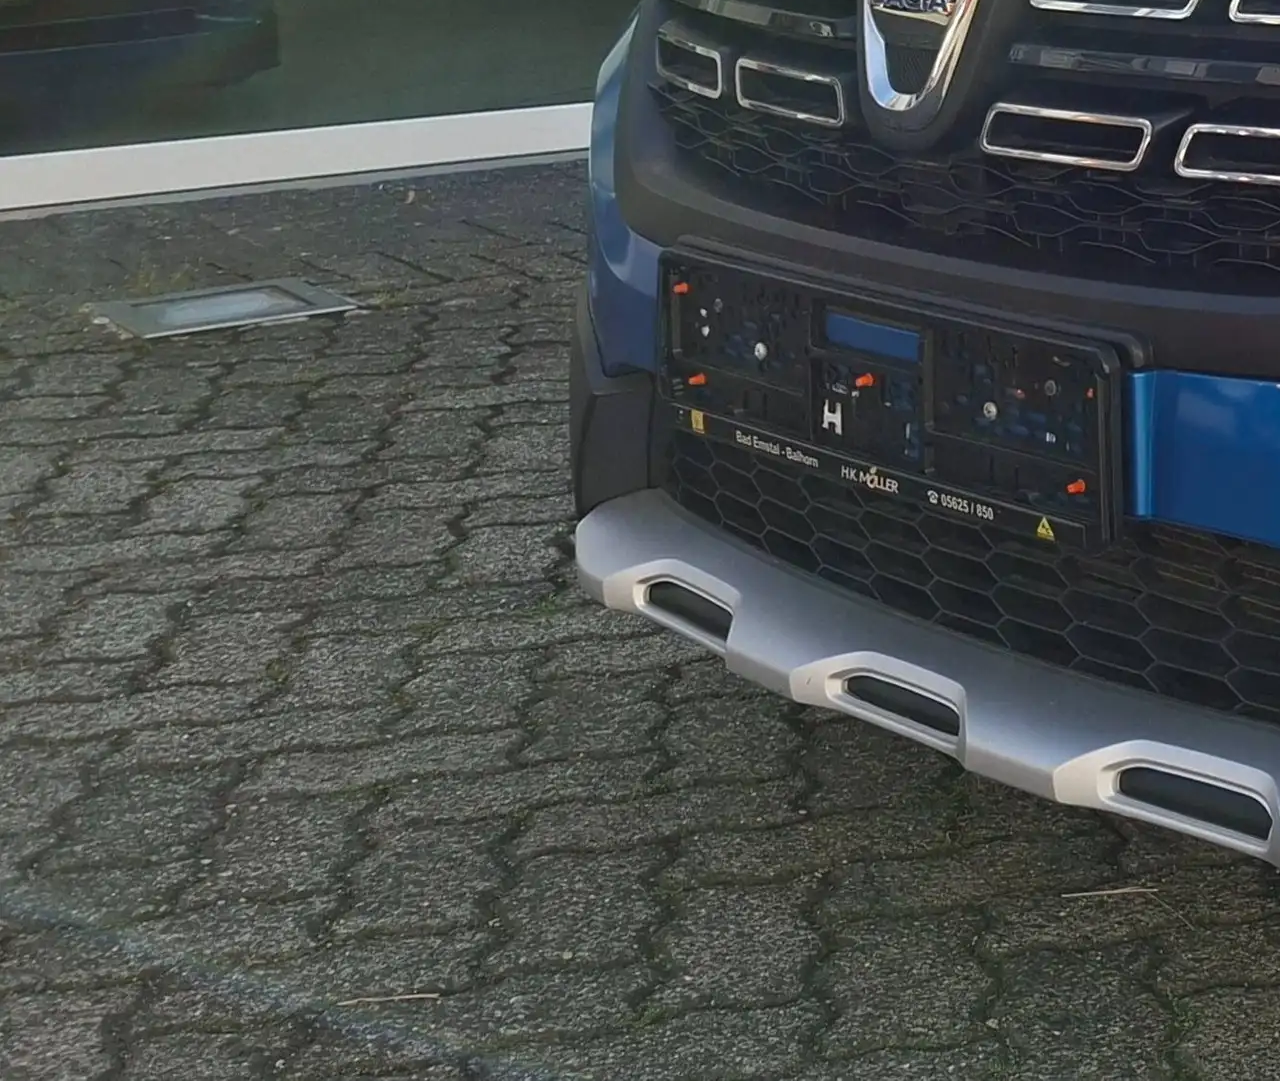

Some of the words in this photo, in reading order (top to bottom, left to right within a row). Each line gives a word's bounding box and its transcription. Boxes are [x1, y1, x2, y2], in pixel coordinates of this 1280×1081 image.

[736, 430, 751, 446] Bad
[753, 436, 780, 456] Emstal
[859, 466, 899, 494] MÖLLER
[941, 494, 969, 513] 05625
[976, 503, 994, 520] 850
